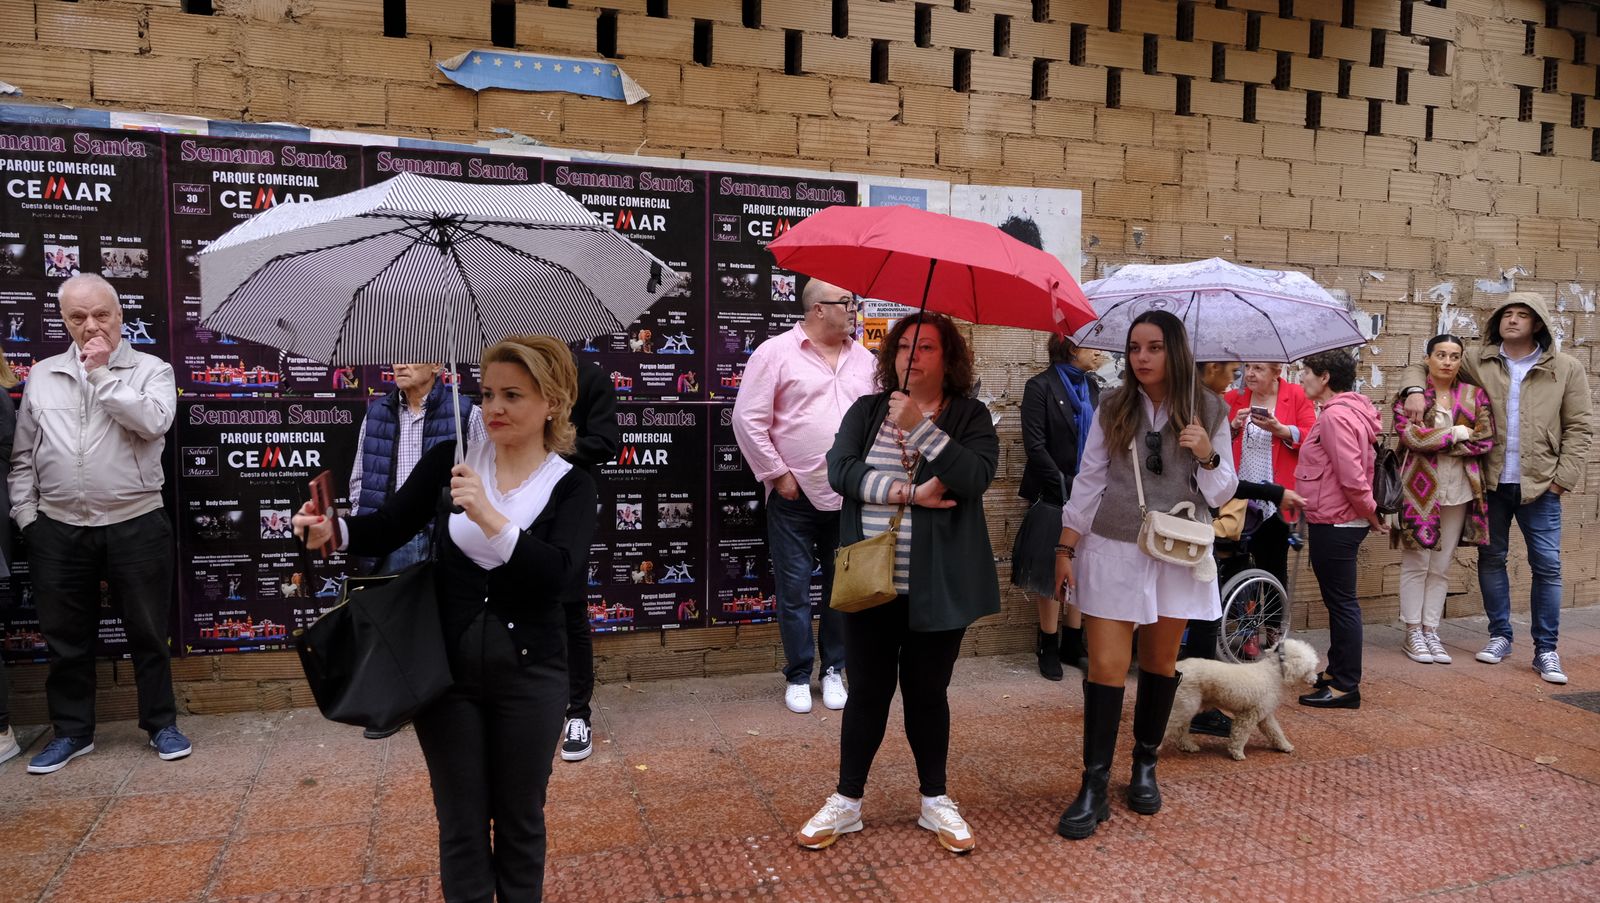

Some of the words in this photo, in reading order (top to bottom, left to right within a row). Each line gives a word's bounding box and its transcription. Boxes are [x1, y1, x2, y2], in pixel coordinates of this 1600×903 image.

[0, 134, 66, 153] mana
[73, 132, 147, 158] Santa
[181, 140, 275, 165] Semana
[281, 146, 347, 169] Santa
[0, 159, 45, 173] PARQUE
[47, 161, 117, 177] COMERCIAL
[377, 152, 462, 177] Semana
[468, 158, 528, 181] Santa
[213, 171, 255, 185] PARQUE
[258, 173, 319, 187] COMERCIAL
[556, 166, 634, 189] Semana
[639, 172, 694, 193] Santa
[7, 176, 112, 203] CEMAR
[187, 194, 198, 203] 30
[720, 176, 791, 199] Semana
[796, 182, 846, 203] Santa
[21, 202, 43, 210] Cuesta
[64, 204, 98, 212] Callejones
[180, 205, 206, 214] Marzo
[582, 194, 617, 206] PARQUE
[619, 196, 671, 209] COMERCIAL
[743, 203, 776, 216] PARQUE
[777, 206, 823, 217] COMERCIA
[723, 224, 732, 232] 30
[747, 218, 791, 237] CEM
[189, 404, 282, 425] Semana
[288, 403, 352, 425] Santa
[642, 408, 696, 426] Santa
[220, 432, 262, 444] PARQUE
[265, 432, 325, 443] COMERCIAL
[622, 433, 672, 443] COMERCIAL
[195, 457, 206, 465] 30
[228, 446, 321, 469] CEMAR
[608, 446, 668, 466] MAR
[188, 468, 214, 476] Marzo
